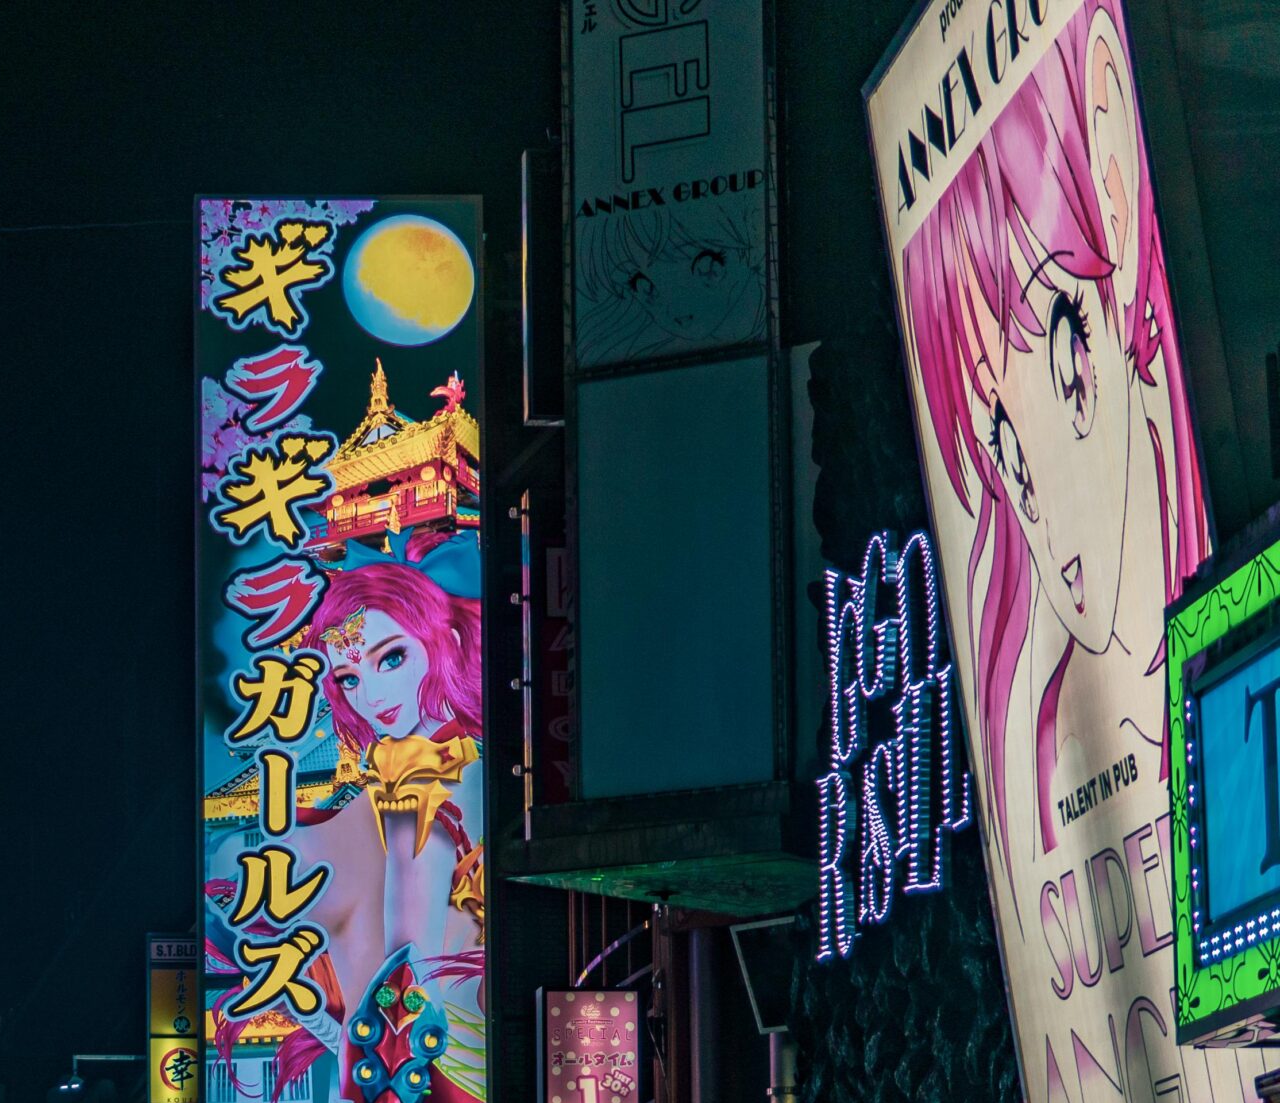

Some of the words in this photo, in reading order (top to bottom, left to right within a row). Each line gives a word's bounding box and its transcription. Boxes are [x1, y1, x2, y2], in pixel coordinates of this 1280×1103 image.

[897, 32, 983, 226] ANNEX
[576, 186, 666, 218] ANNEX
[673, 168, 765, 203] GROUP
[216, 220, 332, 1019] ギラギラガールズ
[1057, 781, 1098, 828] TALENT
[1099, 771, 1114, 802] IN
[1114, 753, 1139, 792] PUB
[1039, 811, 1176, 1001] SUPE
[552, 1026, 633, 1042] SPECIAL
[552, 1052, 632, 1067] オールタイム
